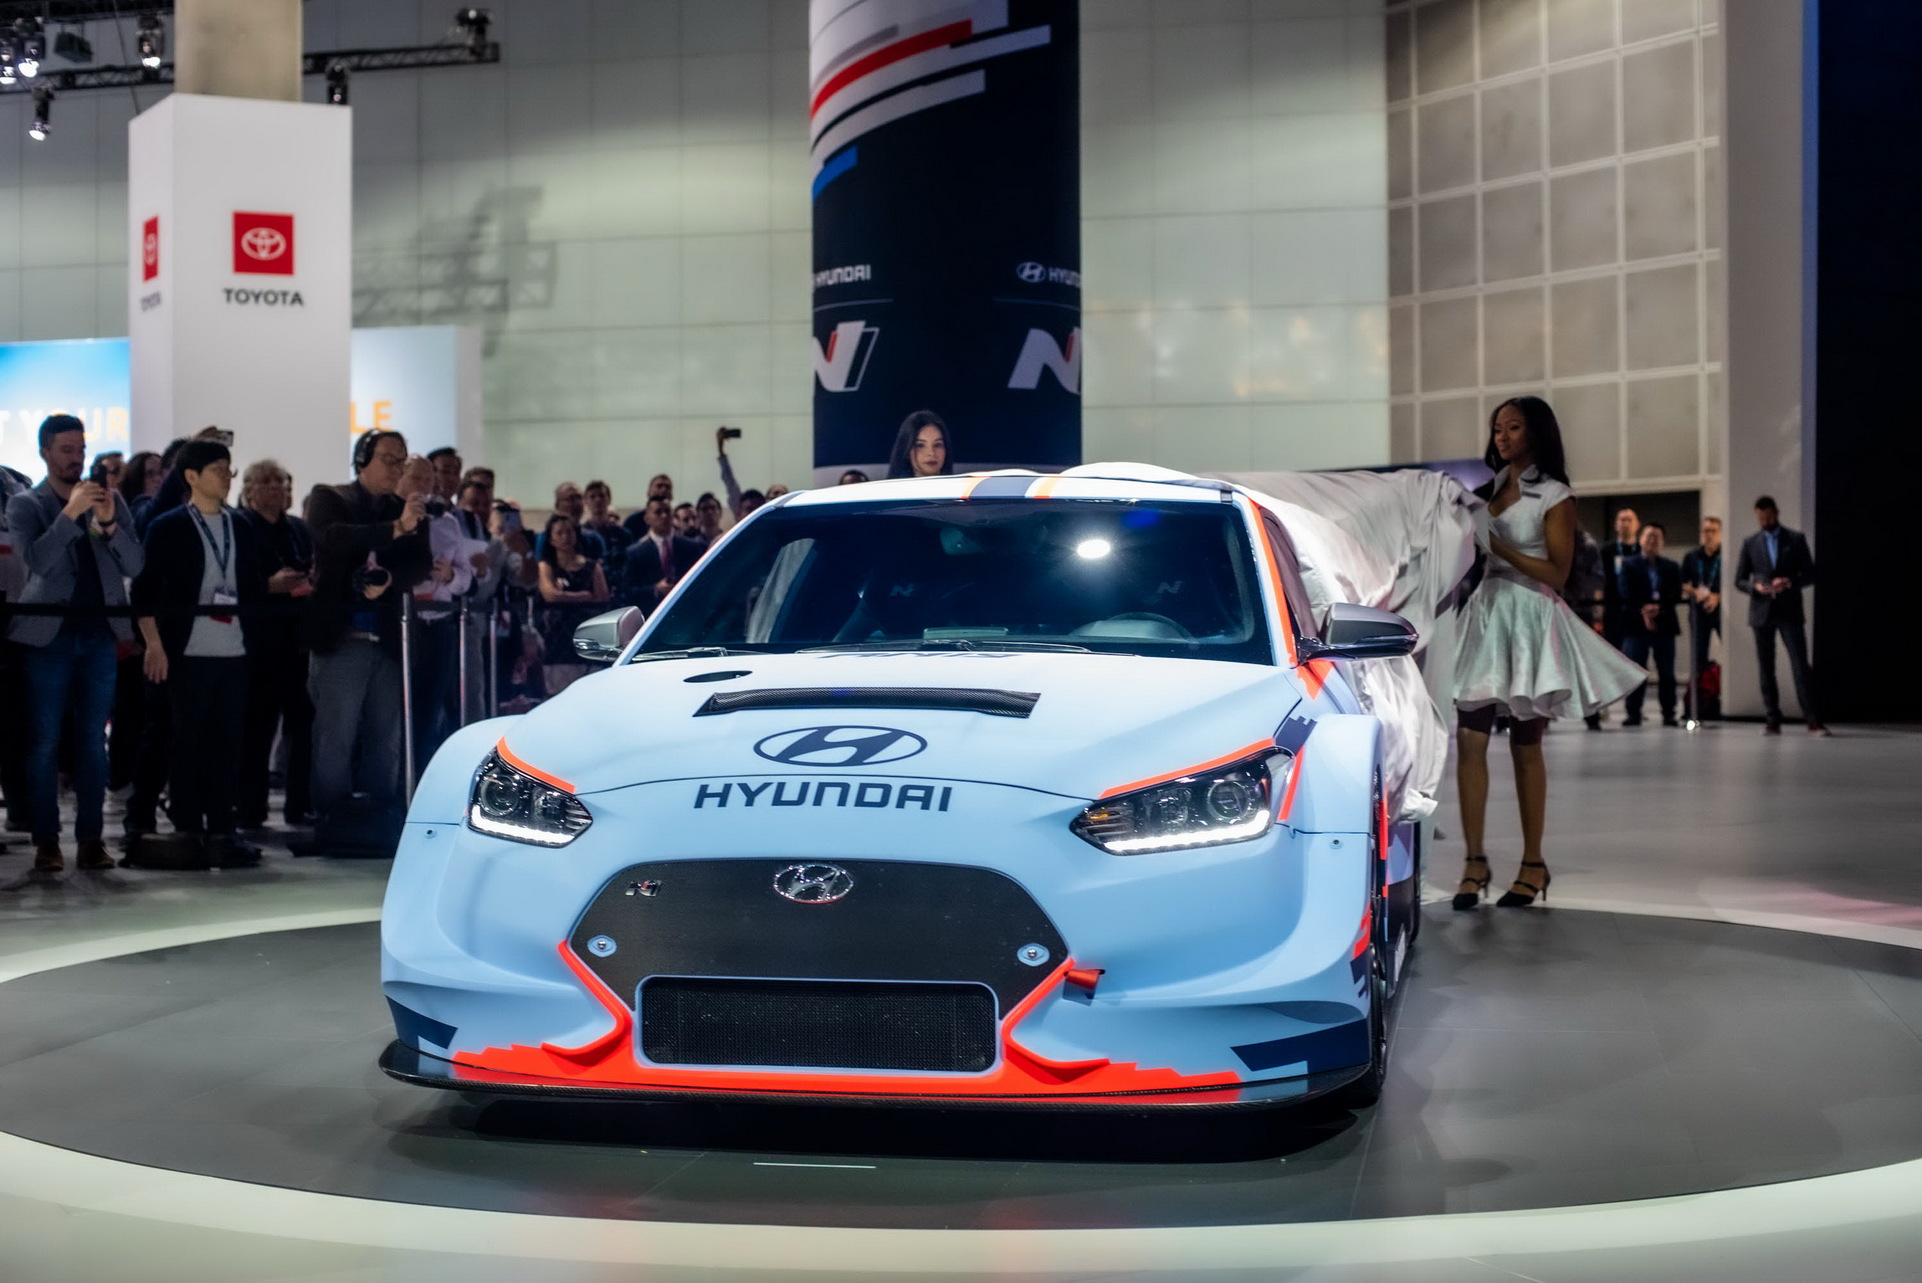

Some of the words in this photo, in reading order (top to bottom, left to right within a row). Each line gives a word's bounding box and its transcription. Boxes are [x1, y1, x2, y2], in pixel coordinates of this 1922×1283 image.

[223, 288, 303, 306] TOYOTA
[18, 407, 129, 443] YUR
[693, 781, 953, 812] HYUNDAI
